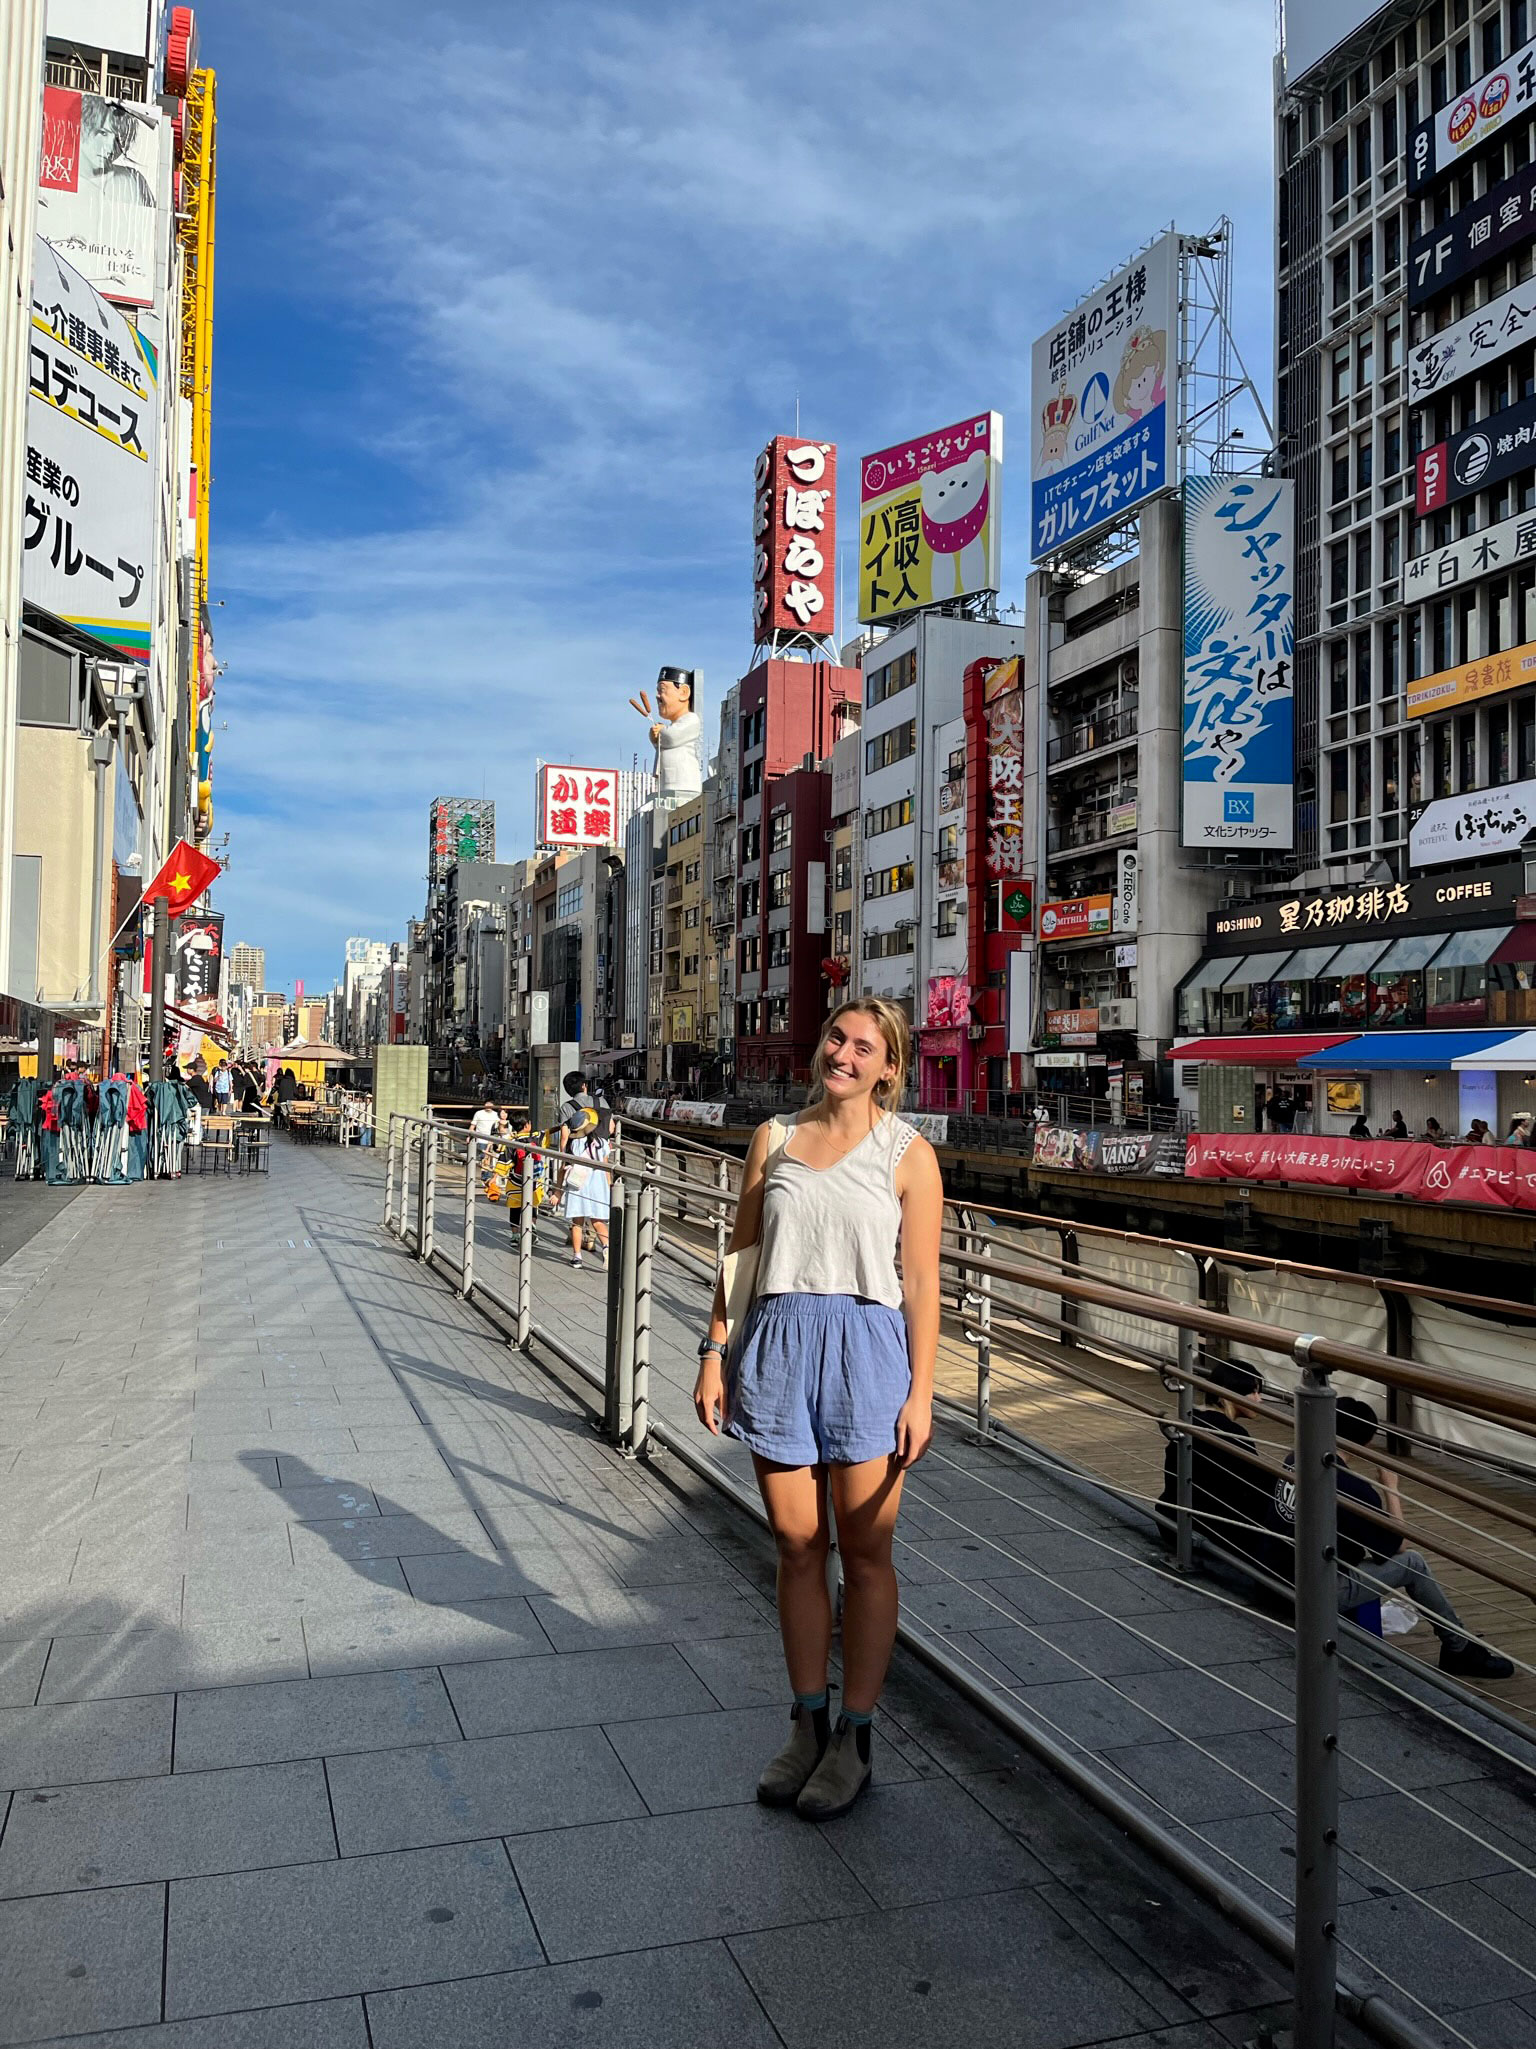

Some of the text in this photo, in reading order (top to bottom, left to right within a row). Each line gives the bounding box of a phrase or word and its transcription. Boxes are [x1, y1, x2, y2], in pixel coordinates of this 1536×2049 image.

[1415, 185, 1536, 287] 7F 個室
[1049, 265, 1147, 370] 店舗の王様
[1051, 306, 1144, 384] 統合ITソリューション
[1468, 302, 1536, 358] 完全
[887, 430, 972, 475] いちごなび
[1044, 426, 1151, 505] ITでチェーン店を改革する
[1497, 421, 1536, 457] 焼肉
[1038, 448, 1159, 549] ガルフネット
[1423, 452, 1440, 507] 5F
[24, 494, 145, 609] グループ
[785, 444, 832, 624] づぼらや
[865, 506, 892, 614] バイト
[892, 498, 921, 607] 高収入
[1409, 518, 1536, 588] 4F 白木屋
[1214, 484, 1292, 695] シャッターは
[1407, 684, 1451, 705] TORIKIZOKU
[551, 774, 610, 806] かに
[985, 712, 1024, 874] 大阪王将
[1228, 799, 1250, 814] BX
[1411, 809, 1422, 820] 2F
[1455, 808, 1527, 841] ぼてぢゅう
[1123, 871, 1133, 902] ZERO
[1217, 881, 1492, 934] HOSHINO 星乃珈琲店 COFFEE
[1057, 914, 1088, 925] MITHILA
[1102, 1145, 1138, 1165] VANS
